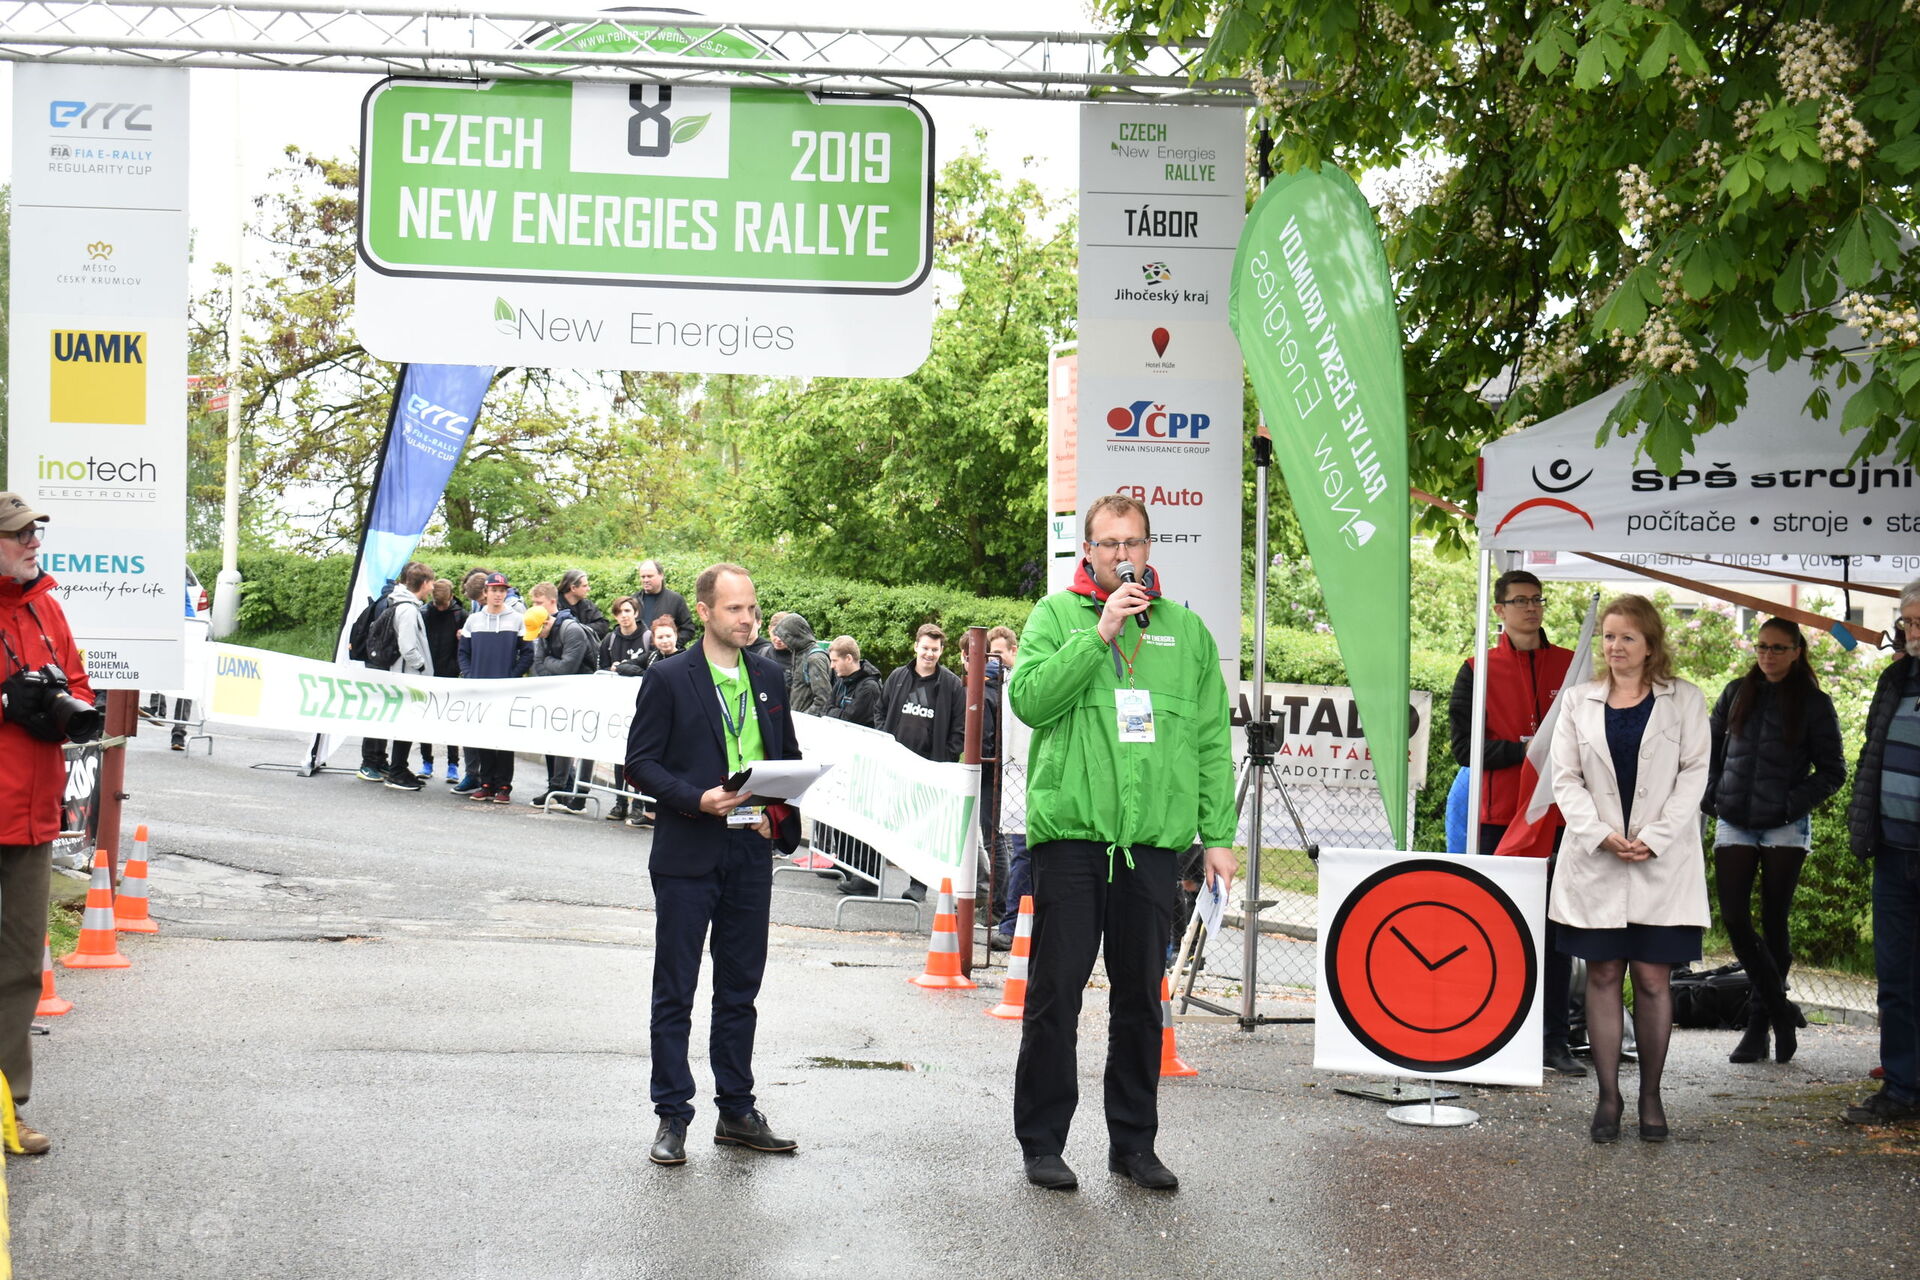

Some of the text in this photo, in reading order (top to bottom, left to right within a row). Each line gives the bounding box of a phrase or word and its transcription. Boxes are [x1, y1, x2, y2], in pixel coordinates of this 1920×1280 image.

[627, 83, 672, 158] 8
[401, 112, 543, 170] CZECH
[1119, 123, 1167, 142] CZECH
[75, 149, 93, 159] FIA
[98, 149, 152, 161] E-RALLY
[790, 130, 891, 184] 2019
[1118, 144, 1216, 162] New Energies
[49, 162, 152, 176] REGULARITY CUP
[1165, 163, 1216, 182] RALLYE
[400, 186, 889, 257] NEW ENERGIES RALLYE
[1124, 204, 1198, 238] TÁBOR
[82, 263, 117, 274] MĚSTO
[57, 274, 142, 286] ČESKÝ KRUMLOV
[1114, 288, 1209, 305] Jihočeský kraj
[517, 308, 795, 357] New Energies
[54, 332, 143, 364] UAMK
[1145, 404, 1211, 438] ČPP
[1106, 444, 1210, 454] VIENNA INSURANCE GROUP
[38, 455, 156, 482] inotech
[1750, 459, 1912, 494] strojní
[39, 489, 156, 499] ELECTRONIC
[1150, 486, 1203, 506] Auto
[1627, 510, 1736, 535] počítače
[1773, 510, 1848, 537] stroje
[36, 553, 145, 574] IEMENS
[117, 581, 138, 597] for
[142, 582, 165, 595] life
[88, 651, 117, 660] SOUTH
[88, 661, 129, 670] BOHEMIA
[216, 655, 262, 680] UAMK
[88, 671, 140, 680] RALLY CLUB
[299, 672, 404, 723] CZECH
[422, 690, 493, 724] New
[901, 702, 935, 719] adidas
